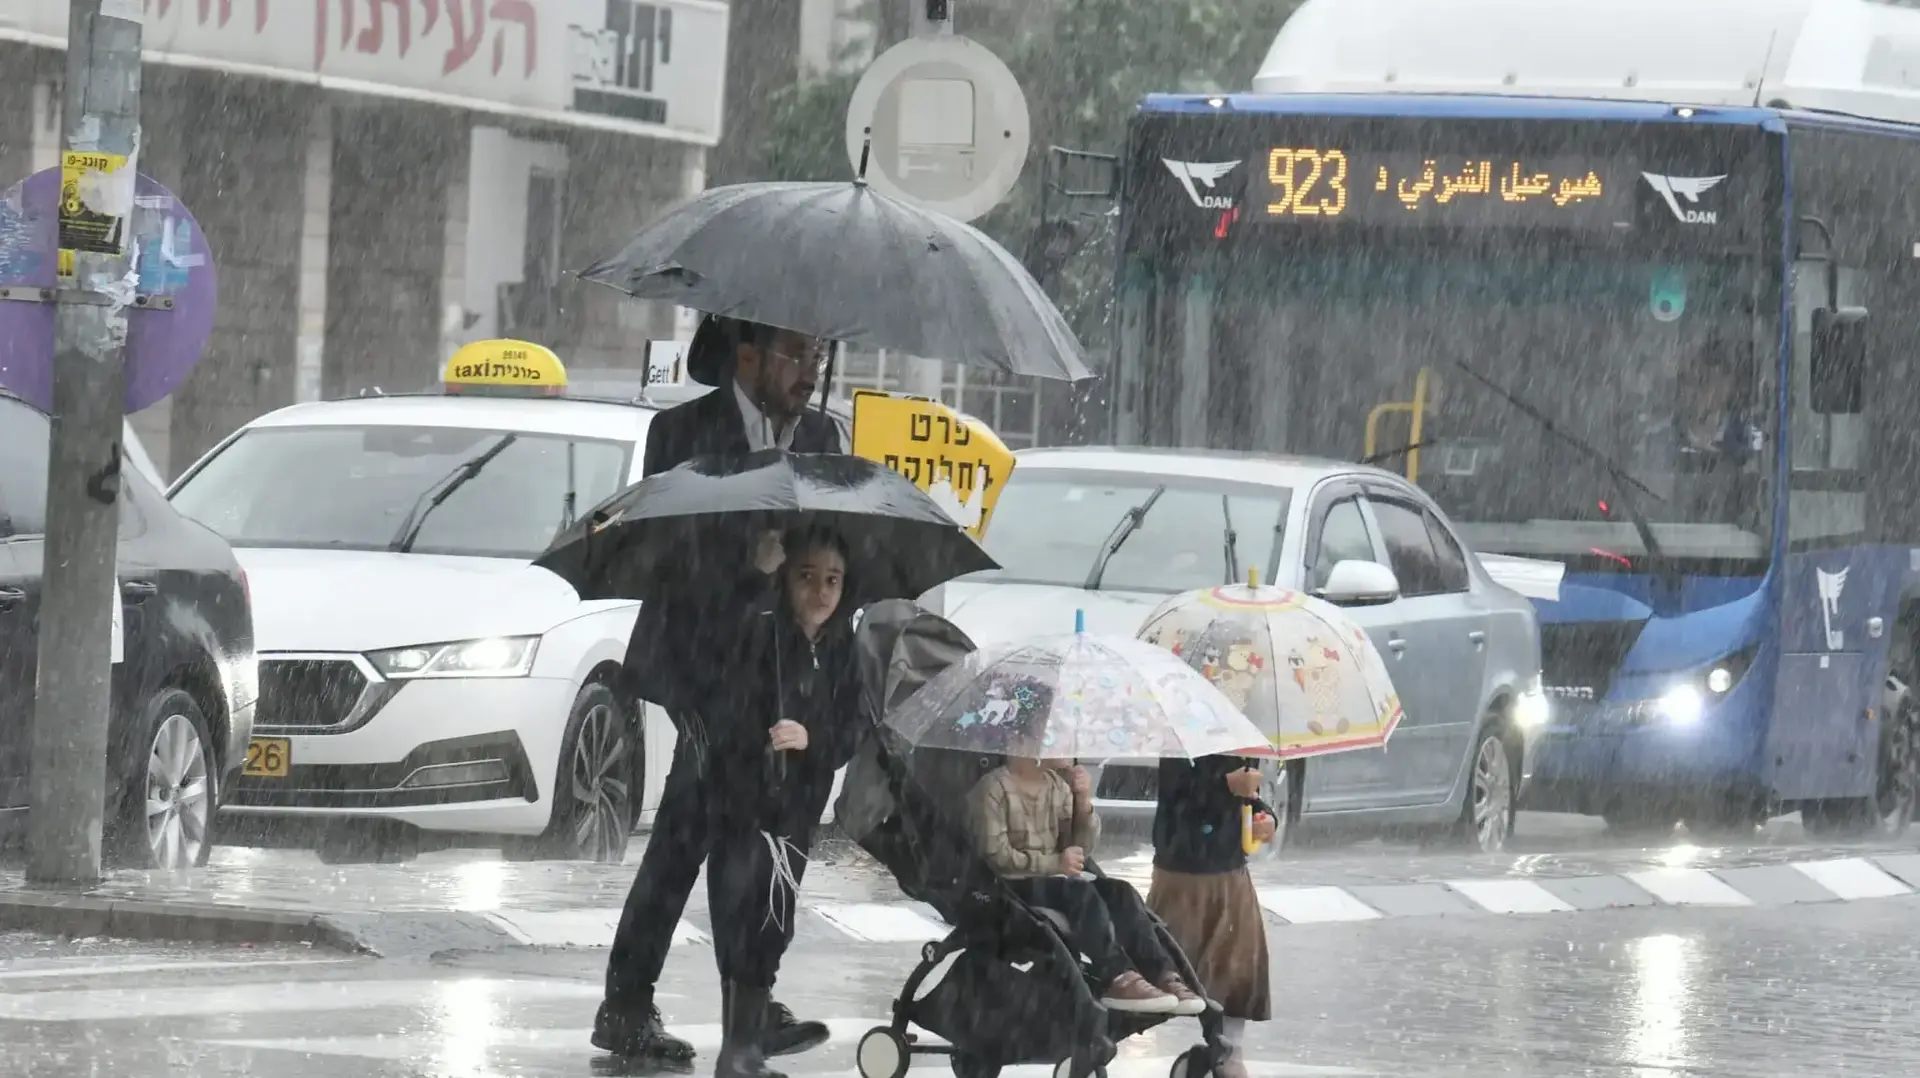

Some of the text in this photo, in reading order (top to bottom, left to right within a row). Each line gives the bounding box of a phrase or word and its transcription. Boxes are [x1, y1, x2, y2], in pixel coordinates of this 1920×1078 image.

[313, 0, 538, 81] העיתון
[1267, 148, 1346, 215] 923
[1398, 159, 1490, 209] الشرقي
[1204, 196, 1232, 209] DAN
[1686, 210, 1717, 224] DAN
[454, 359, 541, 379] taxi מונית
[649, 364, 669, 384] Gett
[911, 413, 970, 445] פרט
[246, 743, 282, 772] 26
